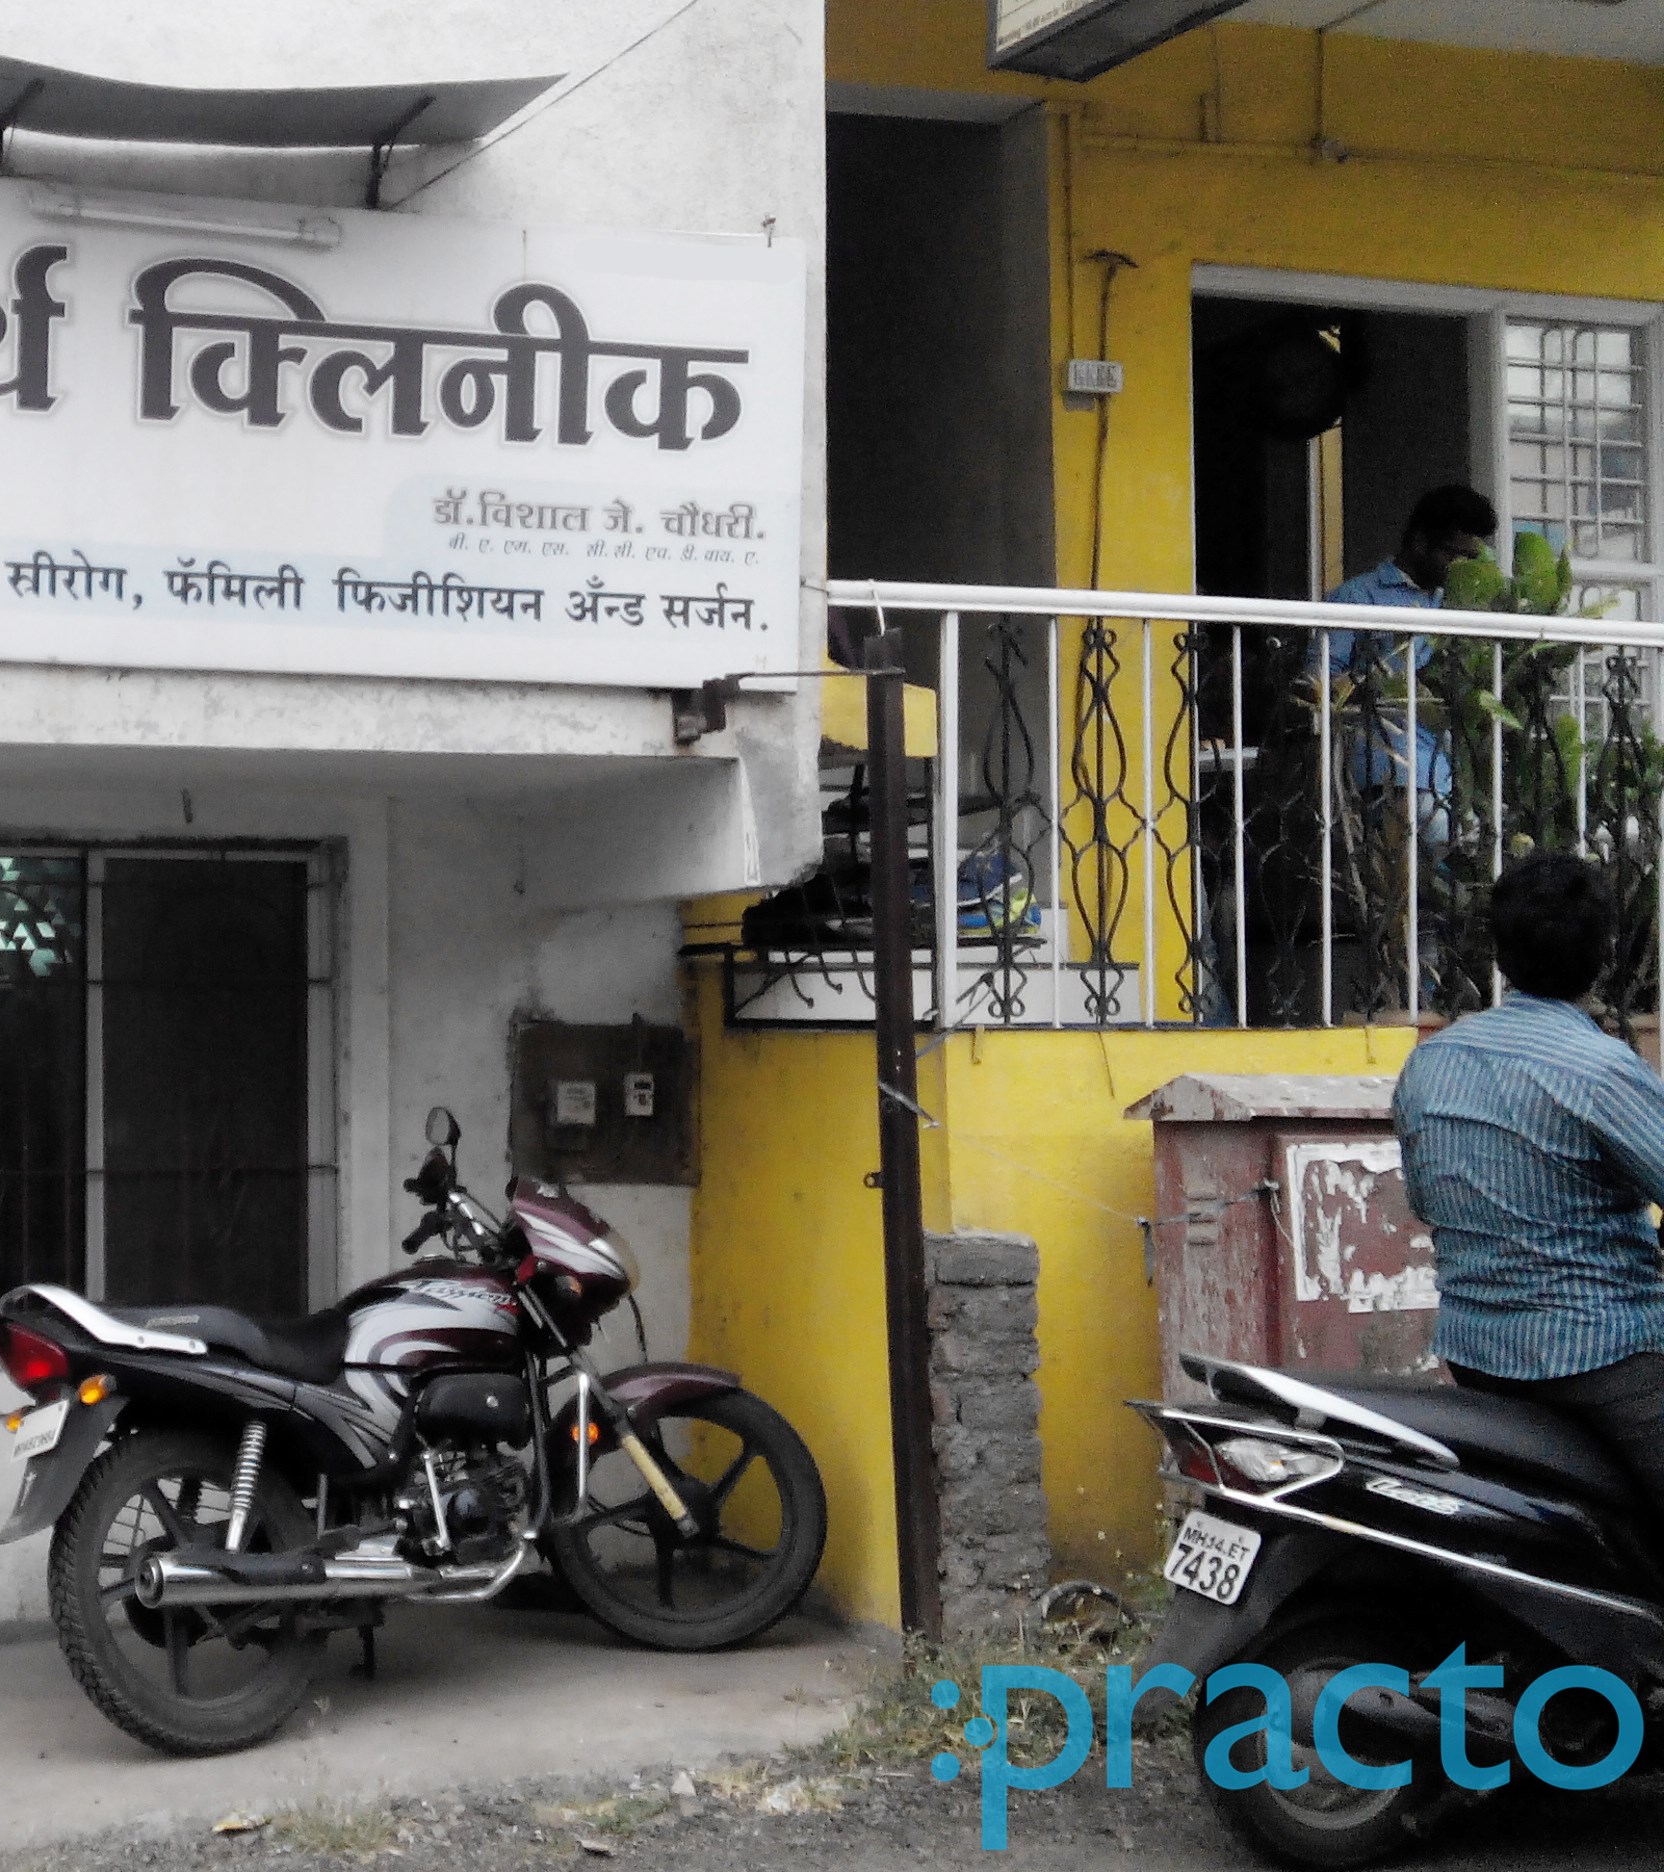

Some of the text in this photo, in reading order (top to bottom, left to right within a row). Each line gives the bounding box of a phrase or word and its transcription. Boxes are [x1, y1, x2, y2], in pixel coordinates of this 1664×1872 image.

[128, 257, 749, 452] क्लिनीक
[603, 498, 643, 533] जे.
[660, 501, 764, 539] चौधरी.
[163, 558, 305, 610] फॅमिली
[332, 567, 545, 621] फिजीशियन
[660, 582, 768, 631] सर्जन.
[1170, 1542, 1240, 1600] 7438
